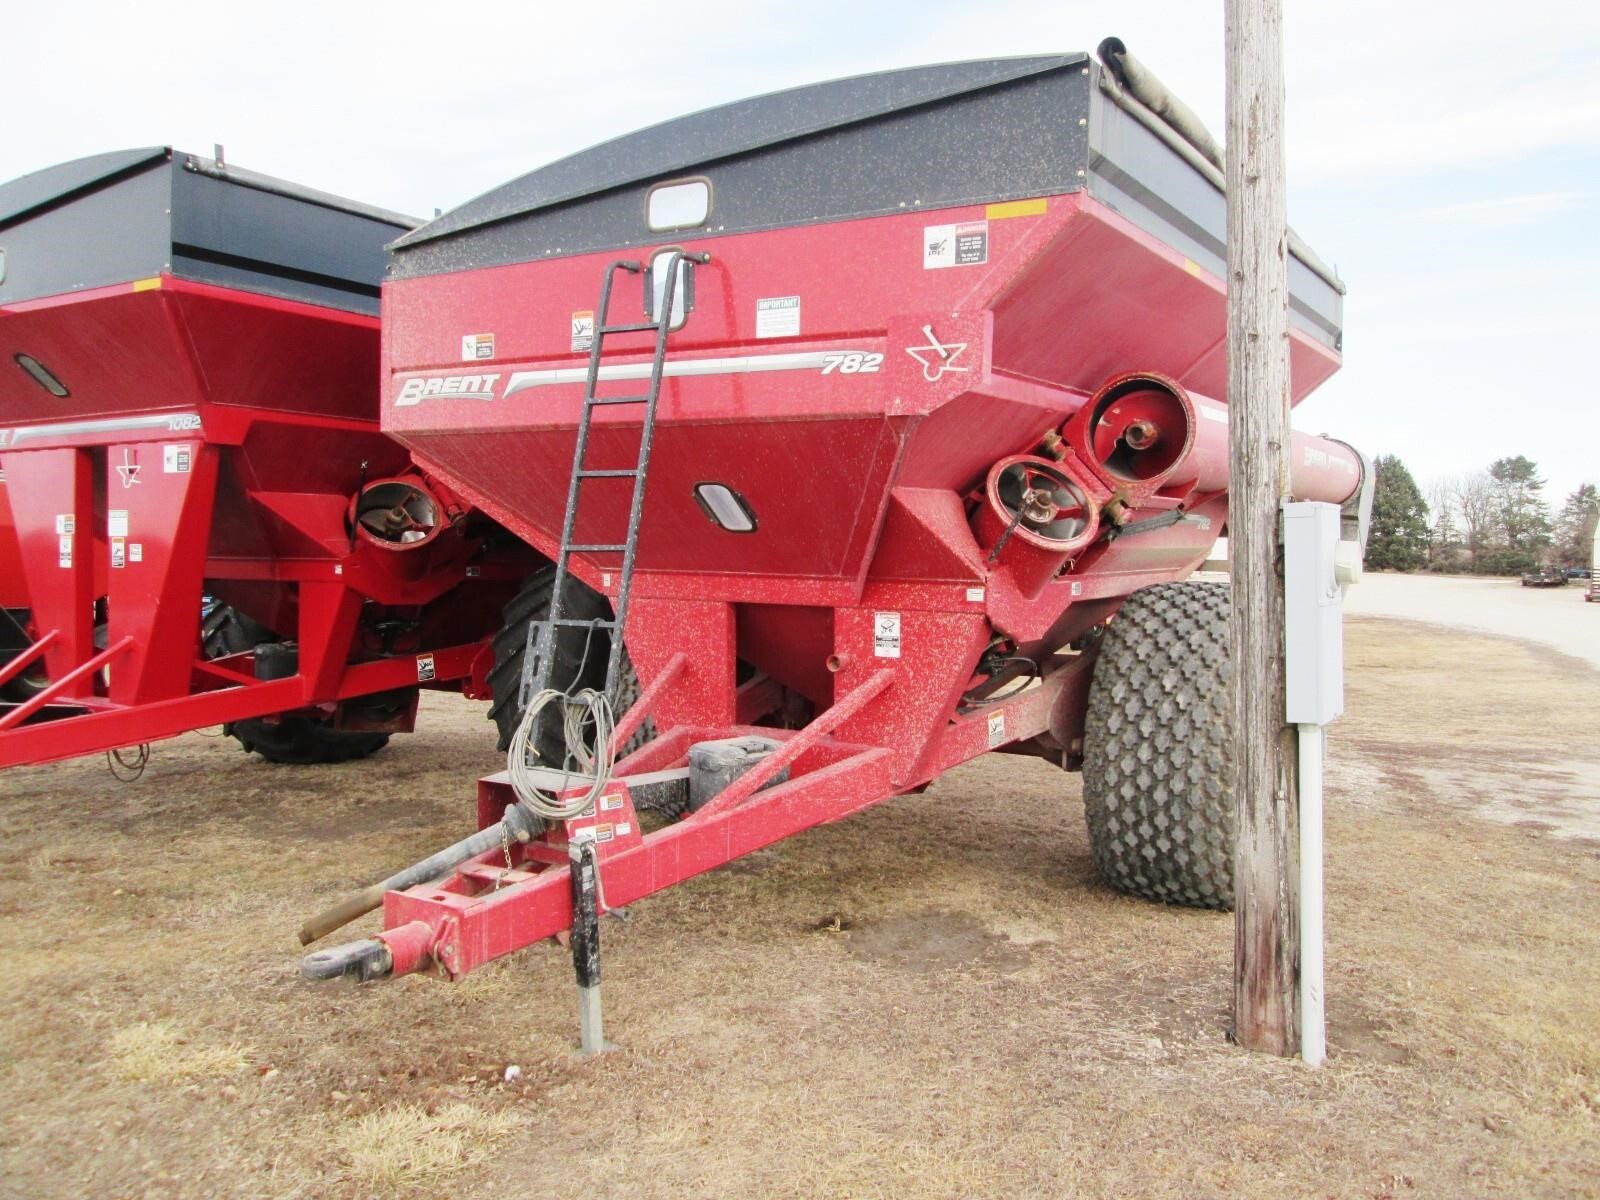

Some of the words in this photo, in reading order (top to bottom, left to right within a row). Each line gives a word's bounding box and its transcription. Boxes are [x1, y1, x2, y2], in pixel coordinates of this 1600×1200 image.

[759, 298, 797, 310] IMPORTANT
[820, 352, 885, 375] 782
[394, 373, 501, 406] BRENT
[169, 415, 202, 431] 1082
